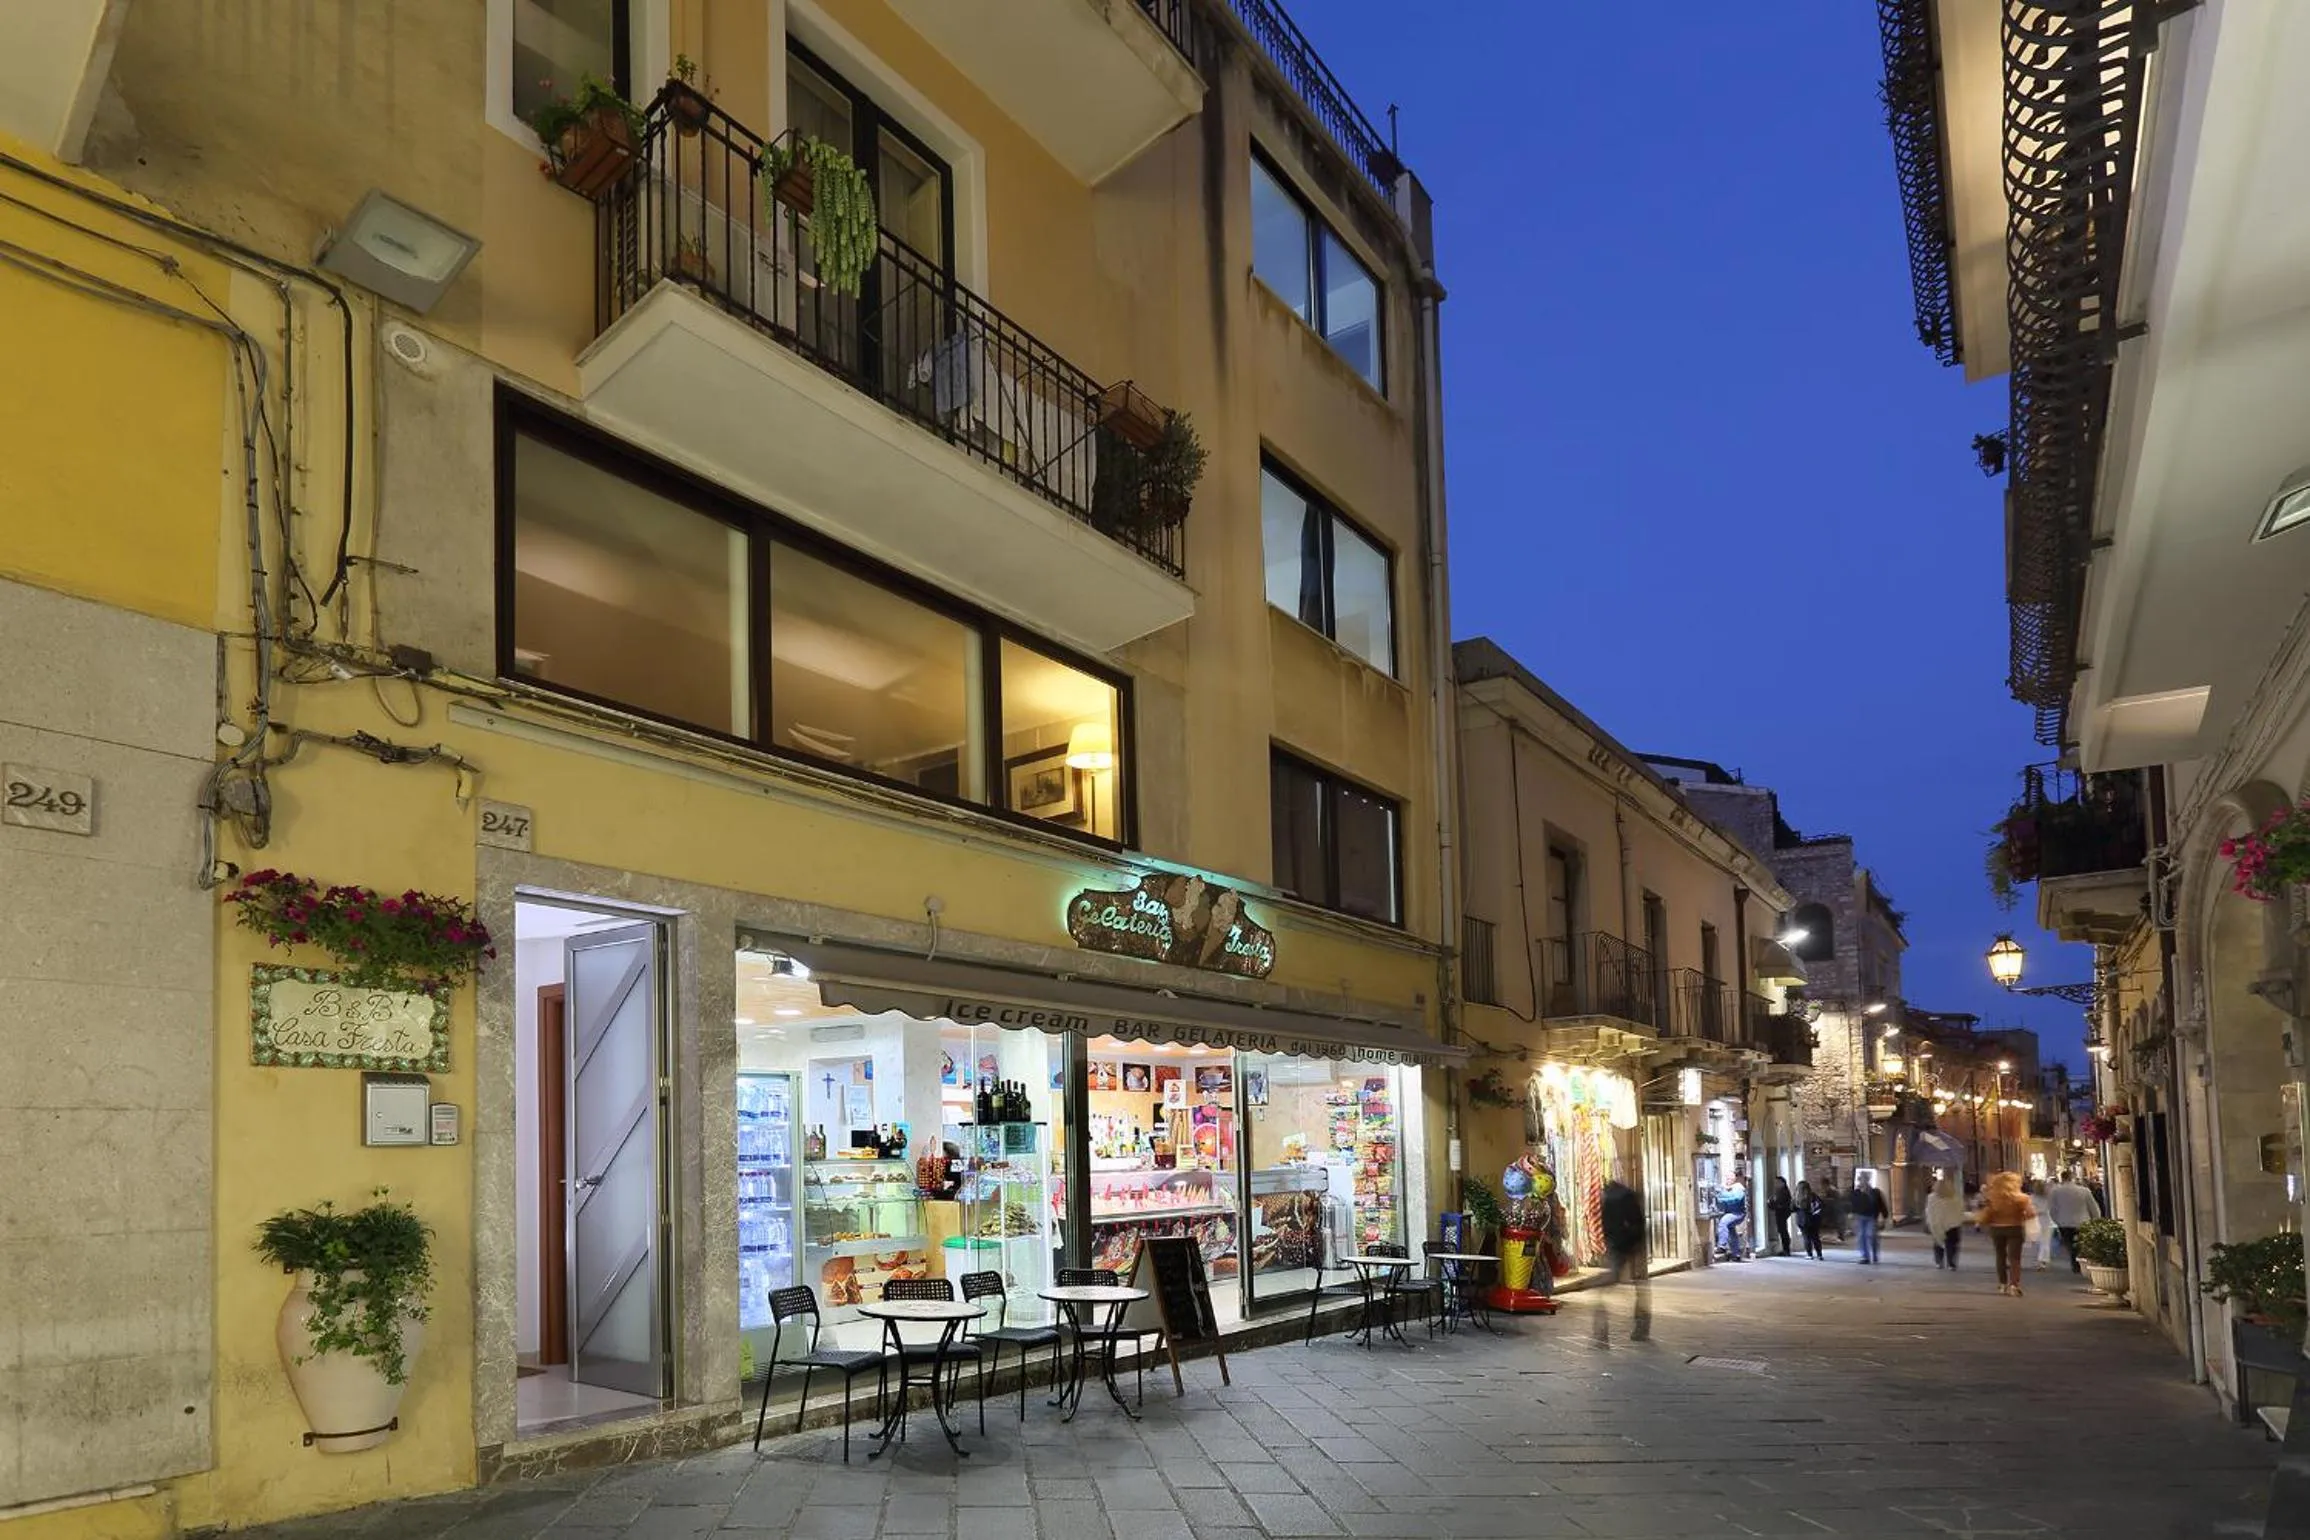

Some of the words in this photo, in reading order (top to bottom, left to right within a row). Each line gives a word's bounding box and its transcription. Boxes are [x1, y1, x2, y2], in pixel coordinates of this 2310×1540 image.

[7, 782, 86, 816] 249
[481, 811, 528, 837] 247
[1132, 890, 1170, 925] Bar
[272, 1017, 329, 1048] Casa
[1000, 1008, 1088, 1031] cream
[1114, 1019, 1160, 1038] BAR
[1173, 1026, 1277, 1050] GELATERIA
[1357, 1047, 1395, 1060] home
